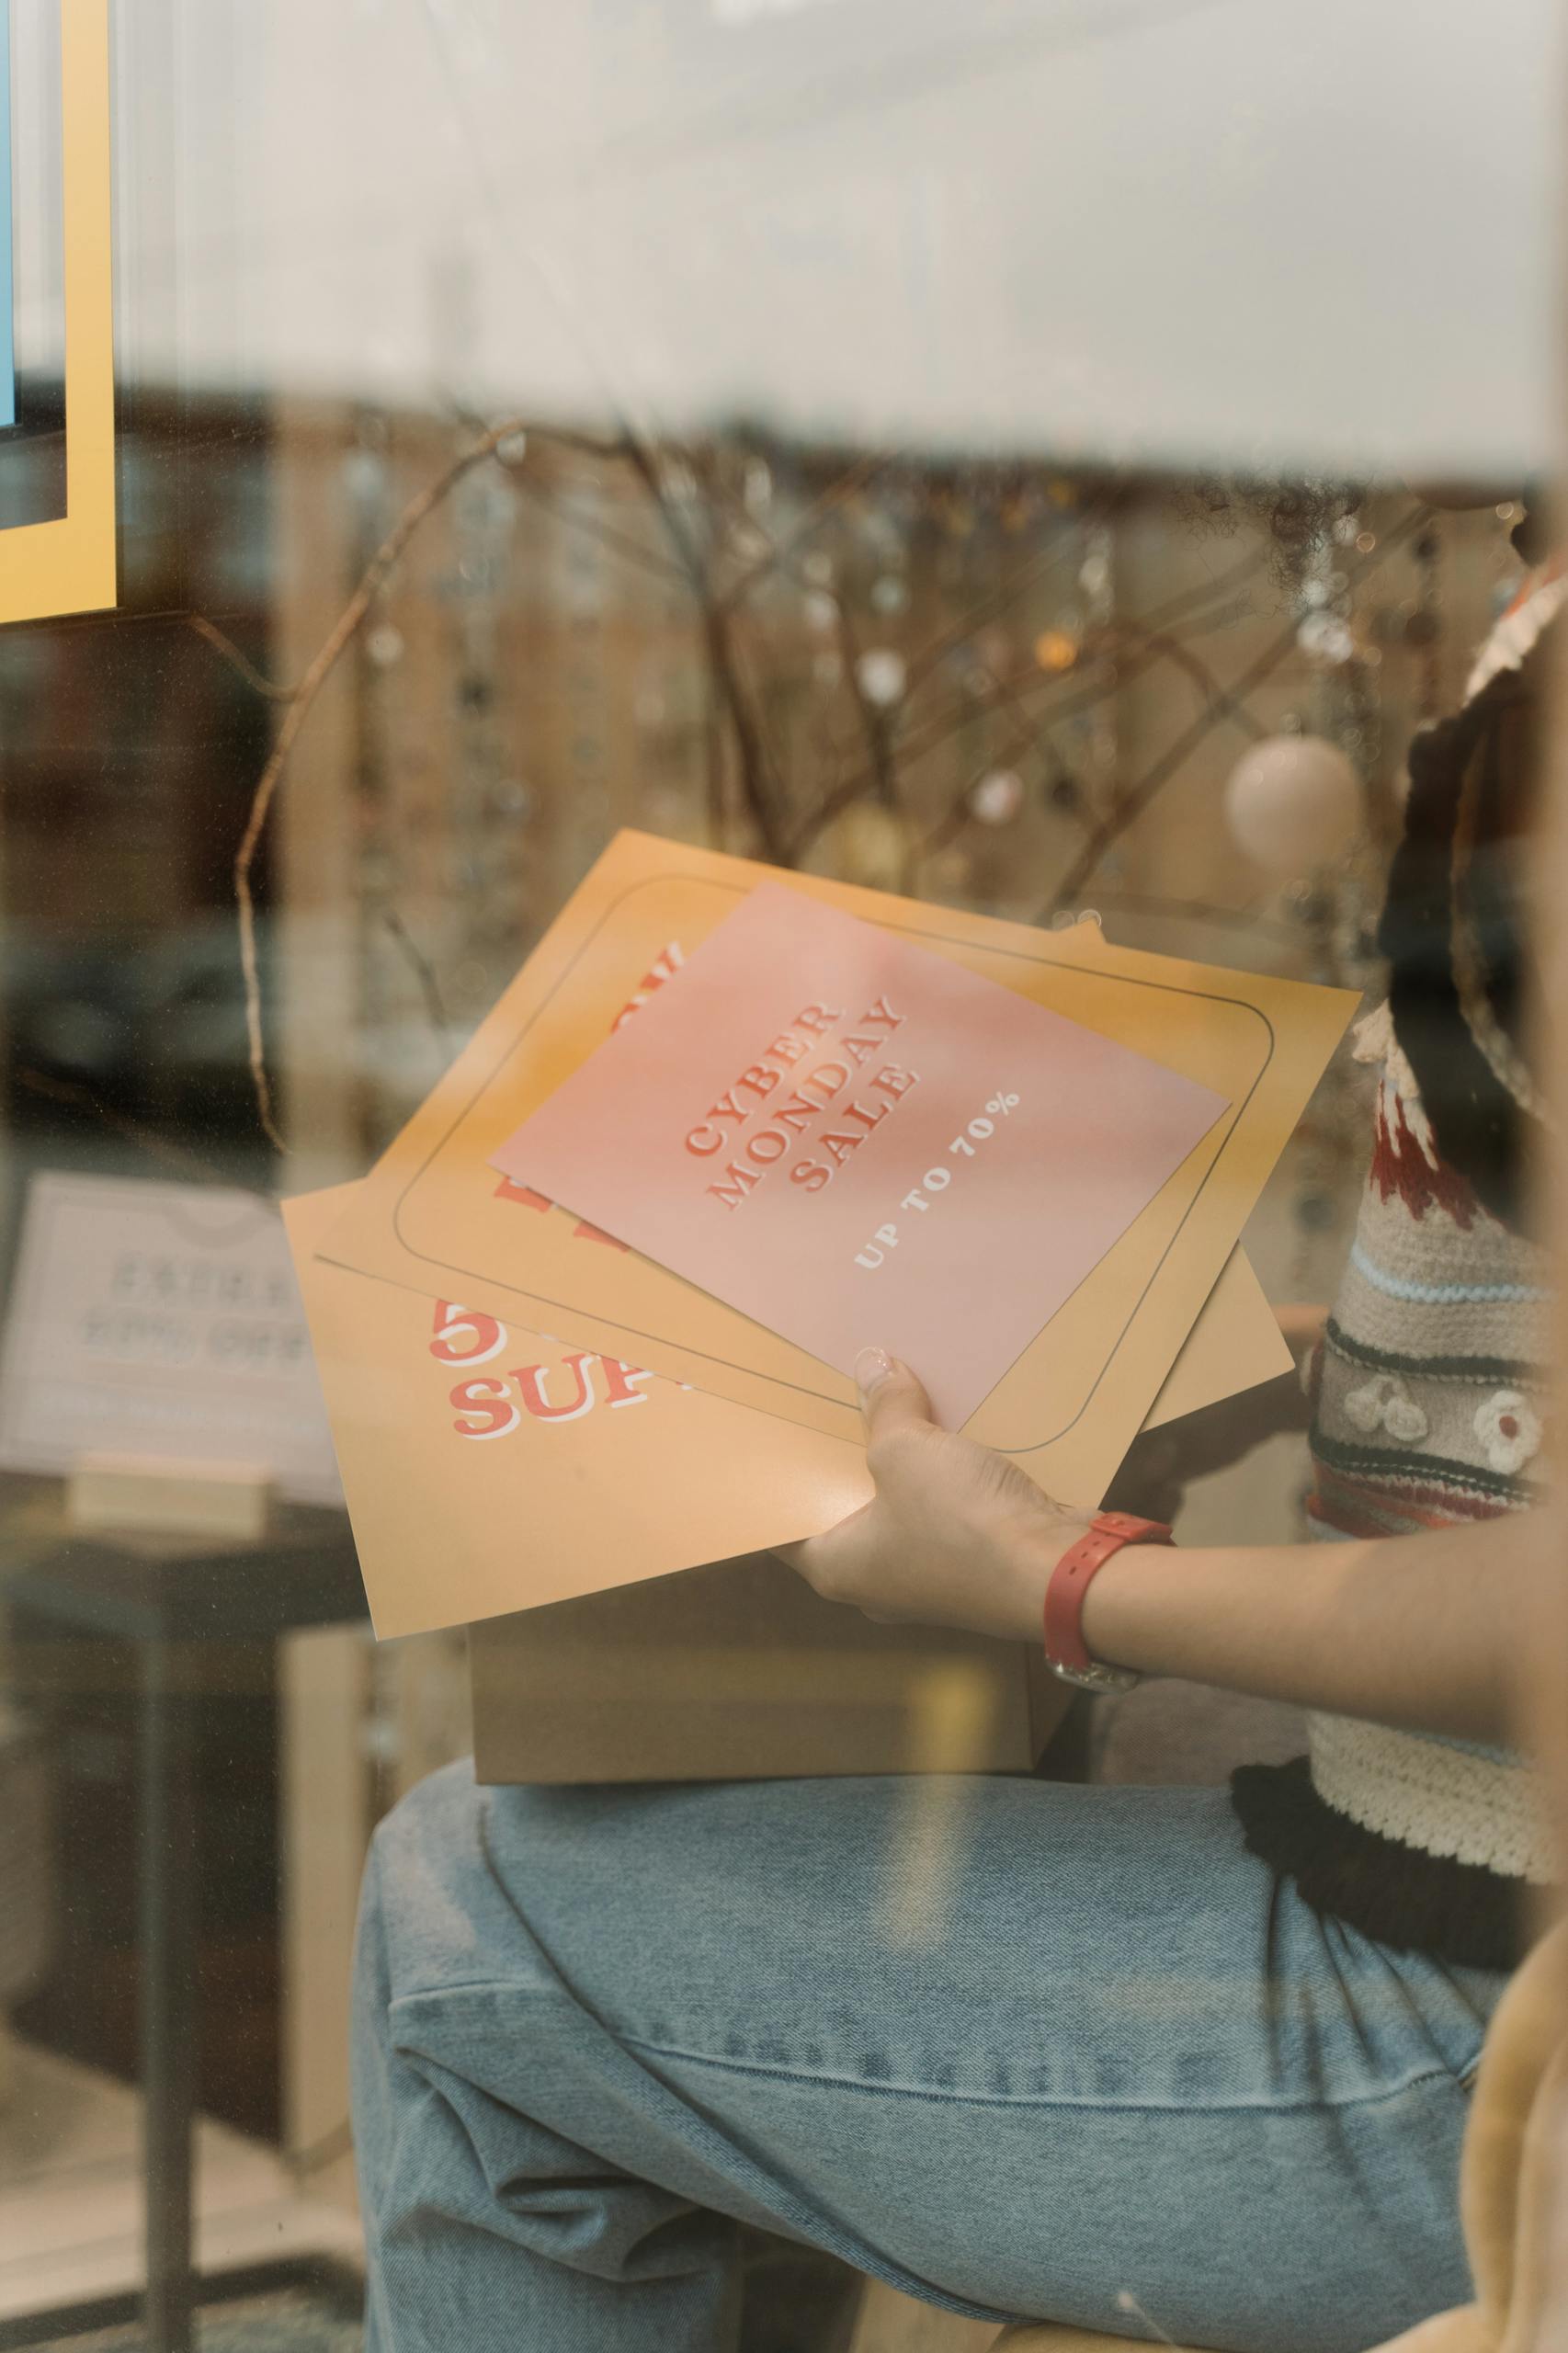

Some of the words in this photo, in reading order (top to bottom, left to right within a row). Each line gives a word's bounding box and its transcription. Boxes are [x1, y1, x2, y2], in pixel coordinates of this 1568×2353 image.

[685, 1001, 845, 1157] CYBER
[706, 995, 907, 1211] MONDAY
[790, 1063, 921, 1193] SALE
[854, 1223, 900, 1269] UP
[901, 1166, 951, 1211] TO
[949, 1091, 1020, 1156] 70%
[429, 1299, 557, 1367] 5
[449, 1352, 691, 1440] SUP
